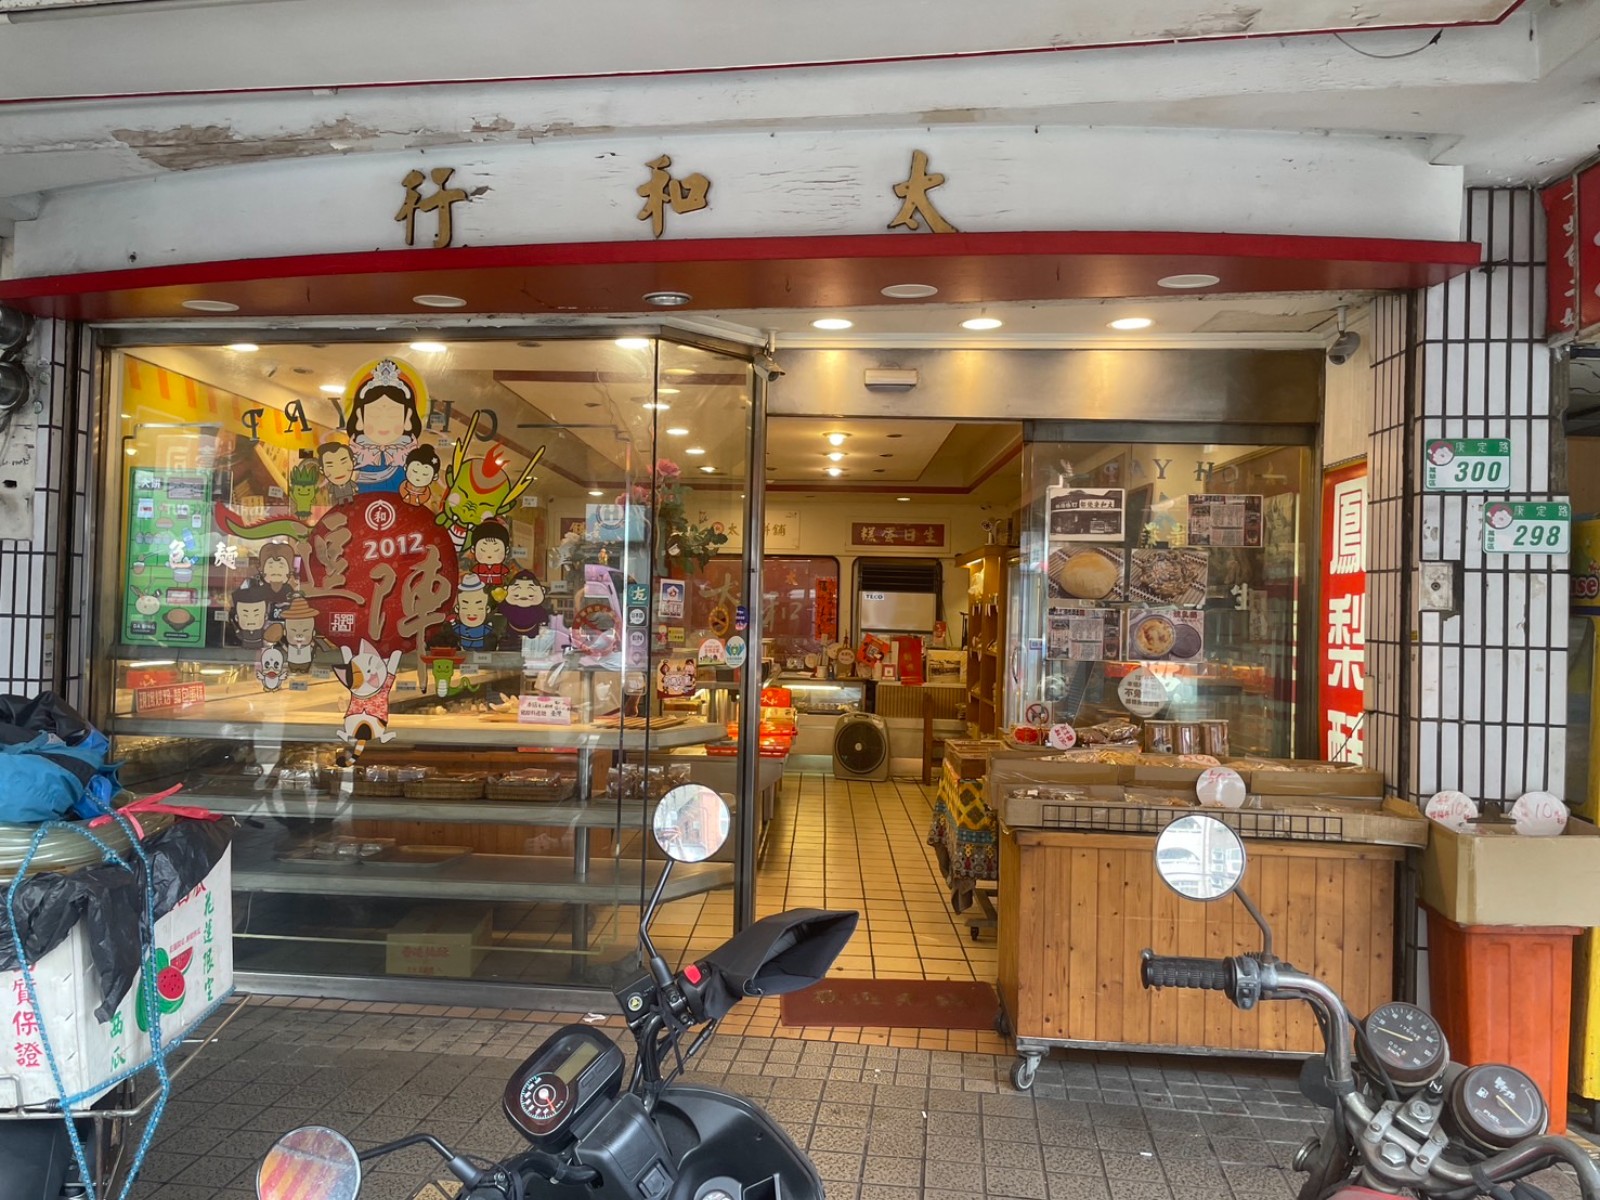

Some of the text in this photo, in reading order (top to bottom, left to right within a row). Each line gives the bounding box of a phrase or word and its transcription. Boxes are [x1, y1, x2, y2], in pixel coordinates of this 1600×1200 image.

[395, 149, 958, 248] 太和行
[1455, 441, 1508, 453] 康定路
[1454, 461, 1502, 482] 300
[1513, 505, 1568, 517] 康定路
[1513, 525, 1561, 546] 298
[363, 533, 426, 561] 2012
[632, 634, 643, 642] EN
[12, 964, 43, 1068] 質保證
